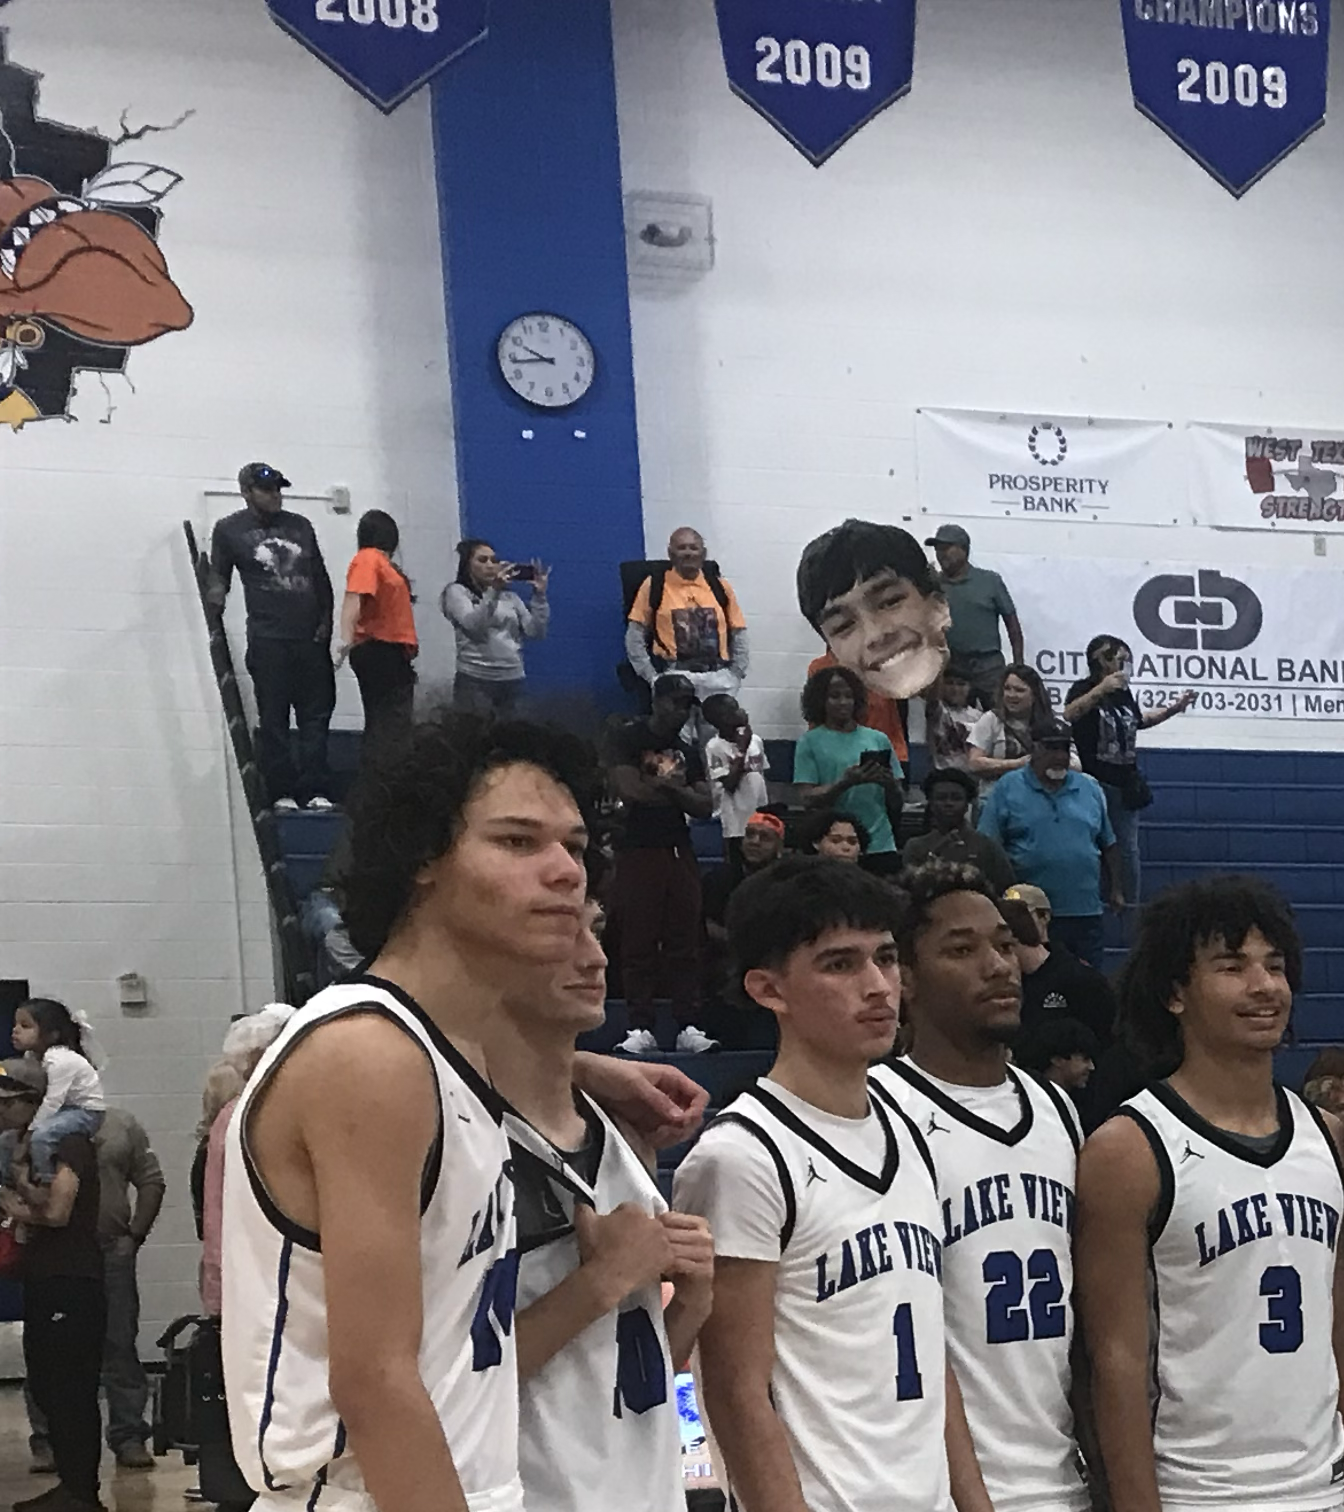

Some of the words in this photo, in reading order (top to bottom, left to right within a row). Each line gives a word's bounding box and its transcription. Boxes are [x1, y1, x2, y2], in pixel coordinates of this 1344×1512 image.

[1134, 0, 1319, 36] CHAMPIONS
[755, 36, 872, 90] 2009
[1176, 57, 1288, 109] 2009
[1245, 435, 1303, 462] WEST
[988, 473, 1110, 495] PROSPERITY
[1023, 495, 1079, 514] BANK
[1035, 649, 1085, 676] CIT
[942, 1173, 1014, 1248] LAKE
[1194, 1192, 1273, 1268] LAKE
[1275, 1192, 1340, 1254] VIEW
[816, 1222, 894, 1304] LAKE
[981, 1248, 1067, 1345] 22
[1258, 1265, 1304, 1354] 3
[893, 1301, 924, 1402] 1
